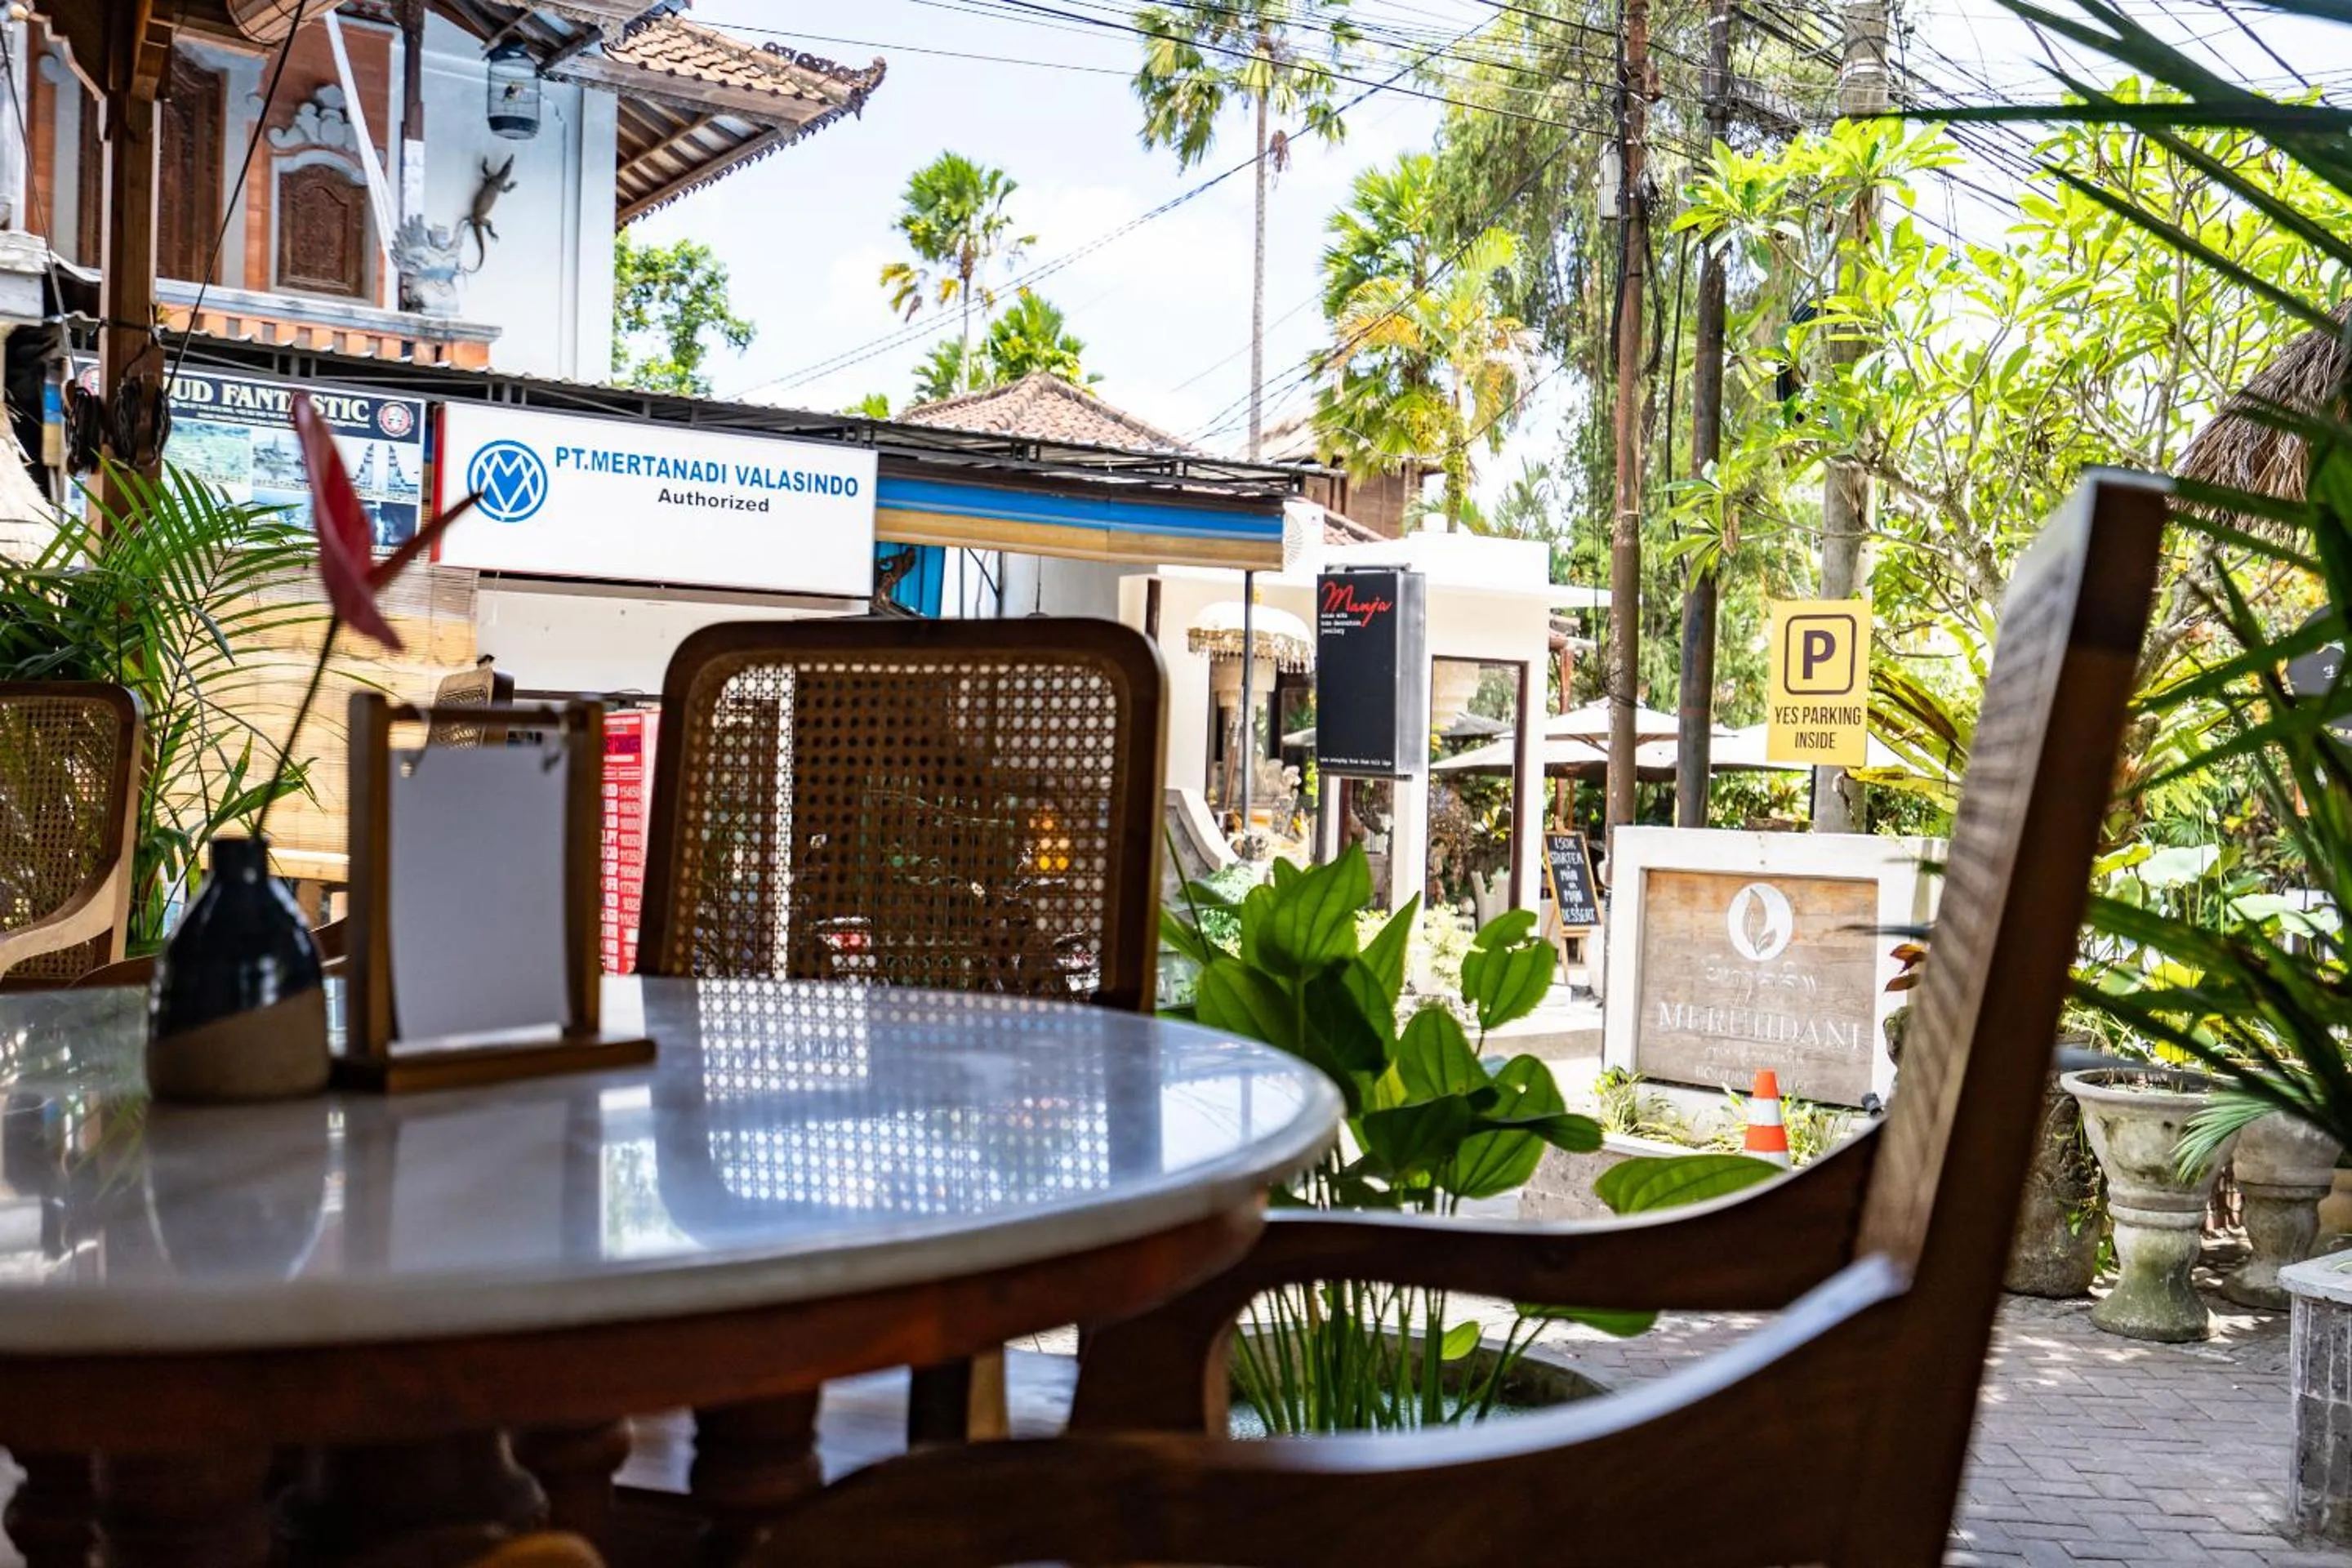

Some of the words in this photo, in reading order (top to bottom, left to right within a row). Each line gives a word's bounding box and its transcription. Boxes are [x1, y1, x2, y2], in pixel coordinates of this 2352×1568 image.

[555, 446, 727, 483] PT.MERTANADI
[736, 466, 858, 498] VALASINDO
[657, 488, 769, 513] Authorized
[1802, 630, 1836, 679] P
[1775, 706, 1799, 725] YES
[1802, 706, 1862, 726] PARKING
[1794, 732, 1837, 749] INSIDE
